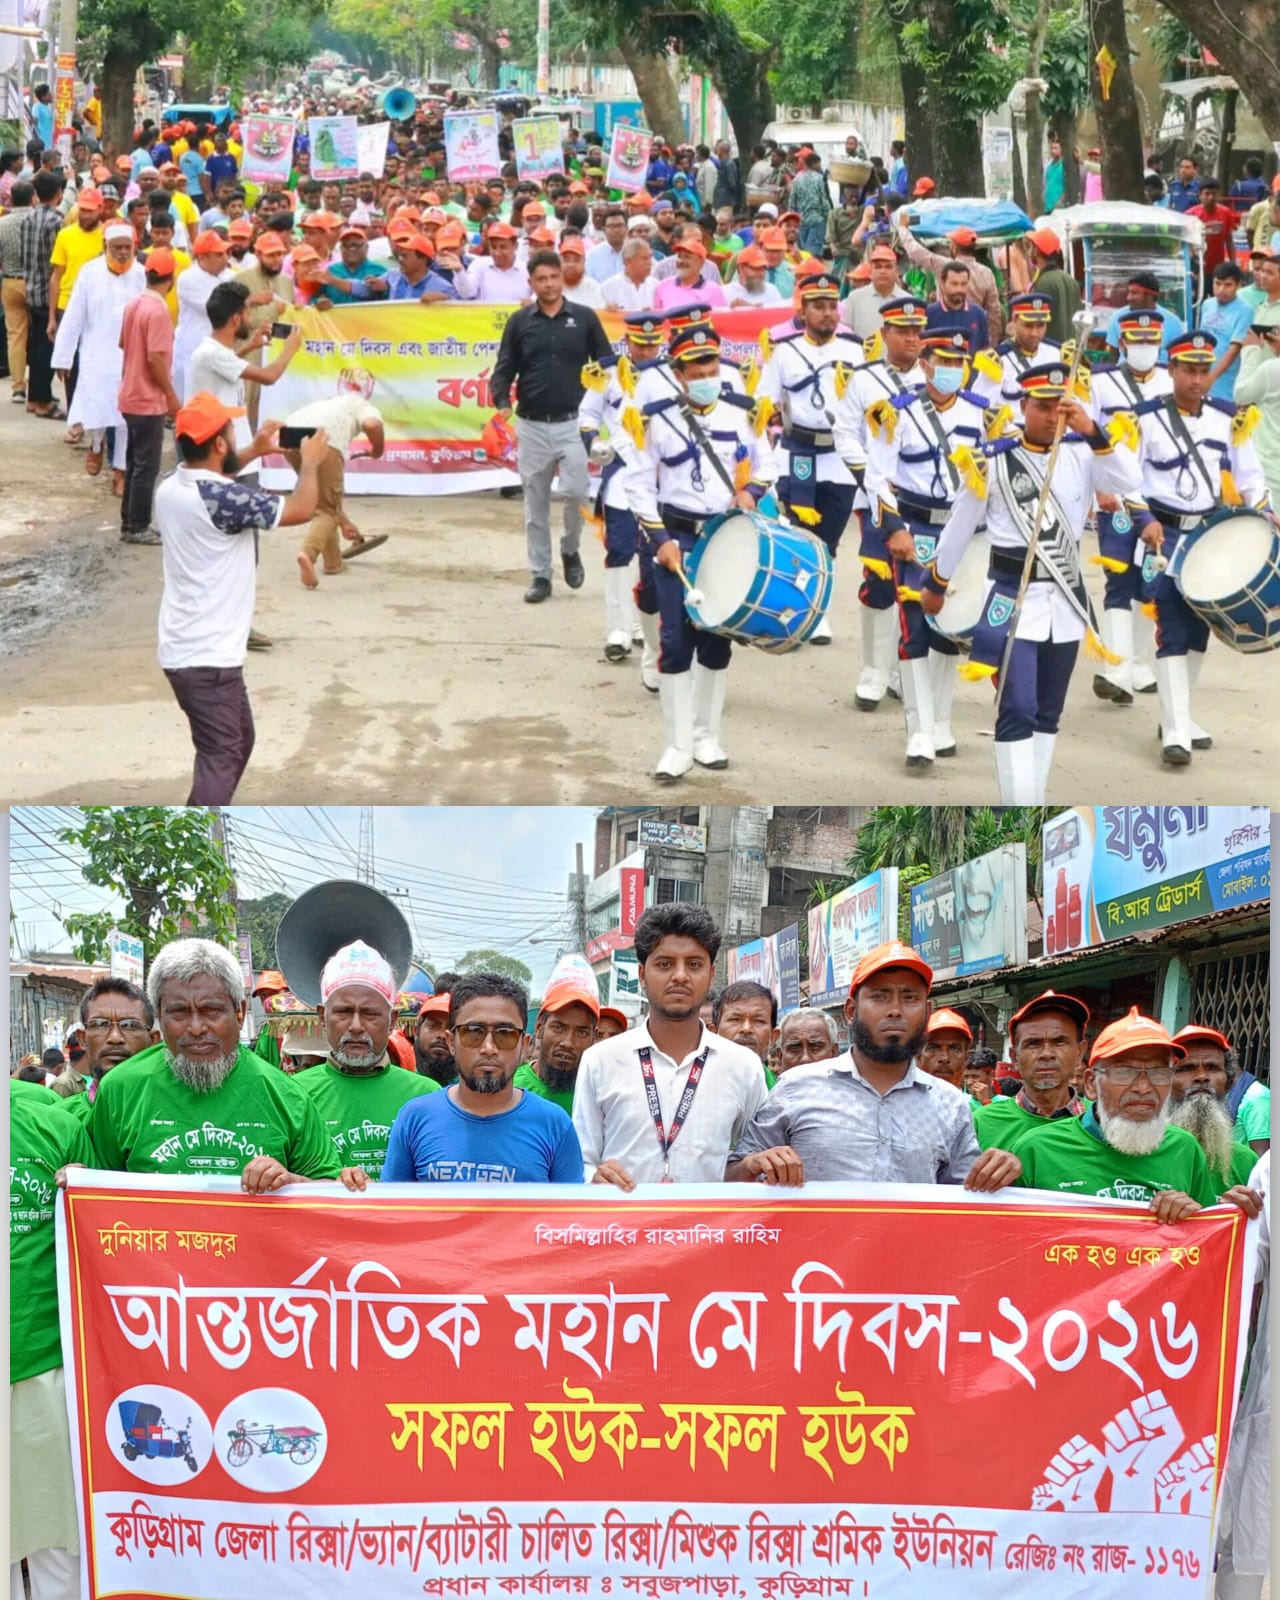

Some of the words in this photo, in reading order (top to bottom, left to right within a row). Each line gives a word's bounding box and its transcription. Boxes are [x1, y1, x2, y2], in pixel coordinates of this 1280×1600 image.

[305, 340, 335, 356] মহান
[360, 337, 392, 356] দিবস
[397, 342, 423, 357] এবং
[427, 337, 467, 357] জাতীয়
[473, 341, 501, 357] পেশ
[1156, 870, 1204, 912] ট্রেডার্স
[647, 1084, 660, 1116] PRESS
[678, 1088, 694, 1119] PRESS
[150, 1135, 185, 1163] মহান
[185, 1130, 200, 1149] মে
[96, 1221, 169, 1257] দুনিয়ার
[174, 1230, 238, 1259] মজদুর
[534, 1223, 639, 1246] বিসমিল্লাহির
[644, 1223, 725, 1246] রাহমানির
[731, 1223, 782, 1246] রাহিম
[1044, 1244, 1081, 1266] এক
[1085, 1245, 1117, 1270] হও
[1126, 1246, 1163, 1268] এক
[1168, 1246, 1201, 1270] হও
[103, 1256, 488, 1373] আন্তর্জাতিক
[504, 1281, 671, 1379] মহান
[689, 1291, 768, 1373] মে
[783, 1260, 1199, 1392] দিবস-২০২৬
[386, 1402, 514, 1473] সফল
[797, 1381, 916, 1484] হউক
[105, 1499, 205, 1562] কুড়িগ্রাম
[215, 1520, 279, 1563] জেলা
[518, 1508, 597, 1563] চালিত
[747, 1510, 807, 1569] রিক্সা
[812, 1510, 885, 1566] শ্রমিক
[890, 1512, 998, 1571] ইউনিয়ন
[1062, 1545, 1087, 1574] নং
[1144, 1545, 1201, 1579] ১১৭৬
[423, 1575, 490, 1597] প্রধান
[496, 1568, 592, 1596] কার্যালয়
[619, 1574, 746, 1599] সবুজপাড়া,
[755, 1571, 854, 1600] কুড়িগ্রাম
